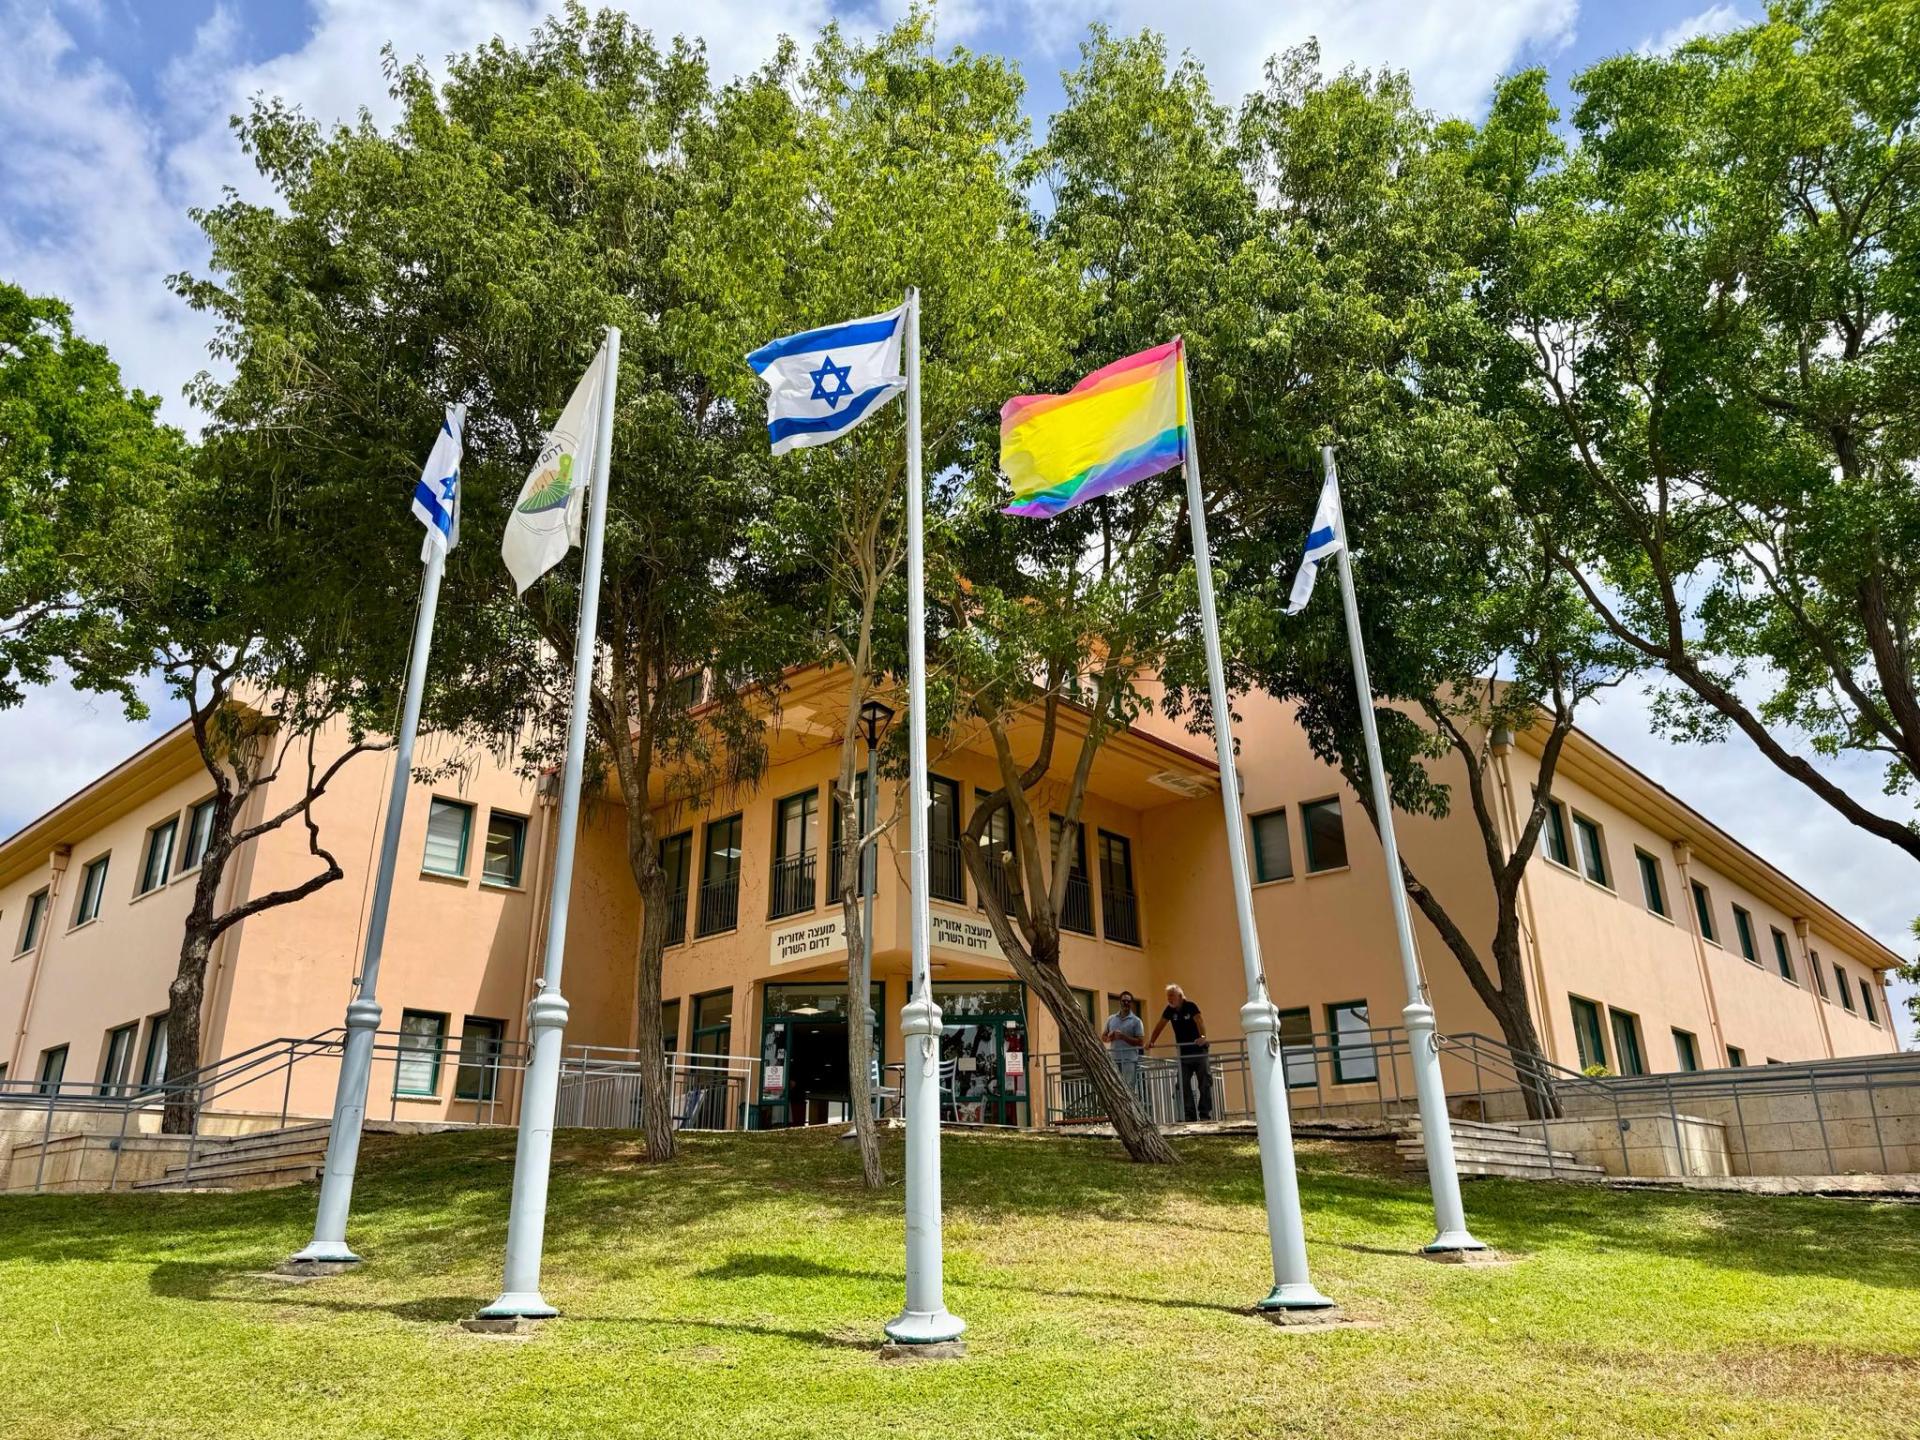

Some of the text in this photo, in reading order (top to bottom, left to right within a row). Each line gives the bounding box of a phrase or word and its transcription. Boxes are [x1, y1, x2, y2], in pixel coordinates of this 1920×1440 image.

[541, 443, 564, 464] דרום
[777, 923, 836, 946] מועצה אזורית
[932, 917, 992, 939] מועצה אזורית
[782, 937, 830, 958] דרום השרון
[938, 930, 988, 950] דרום השרון
